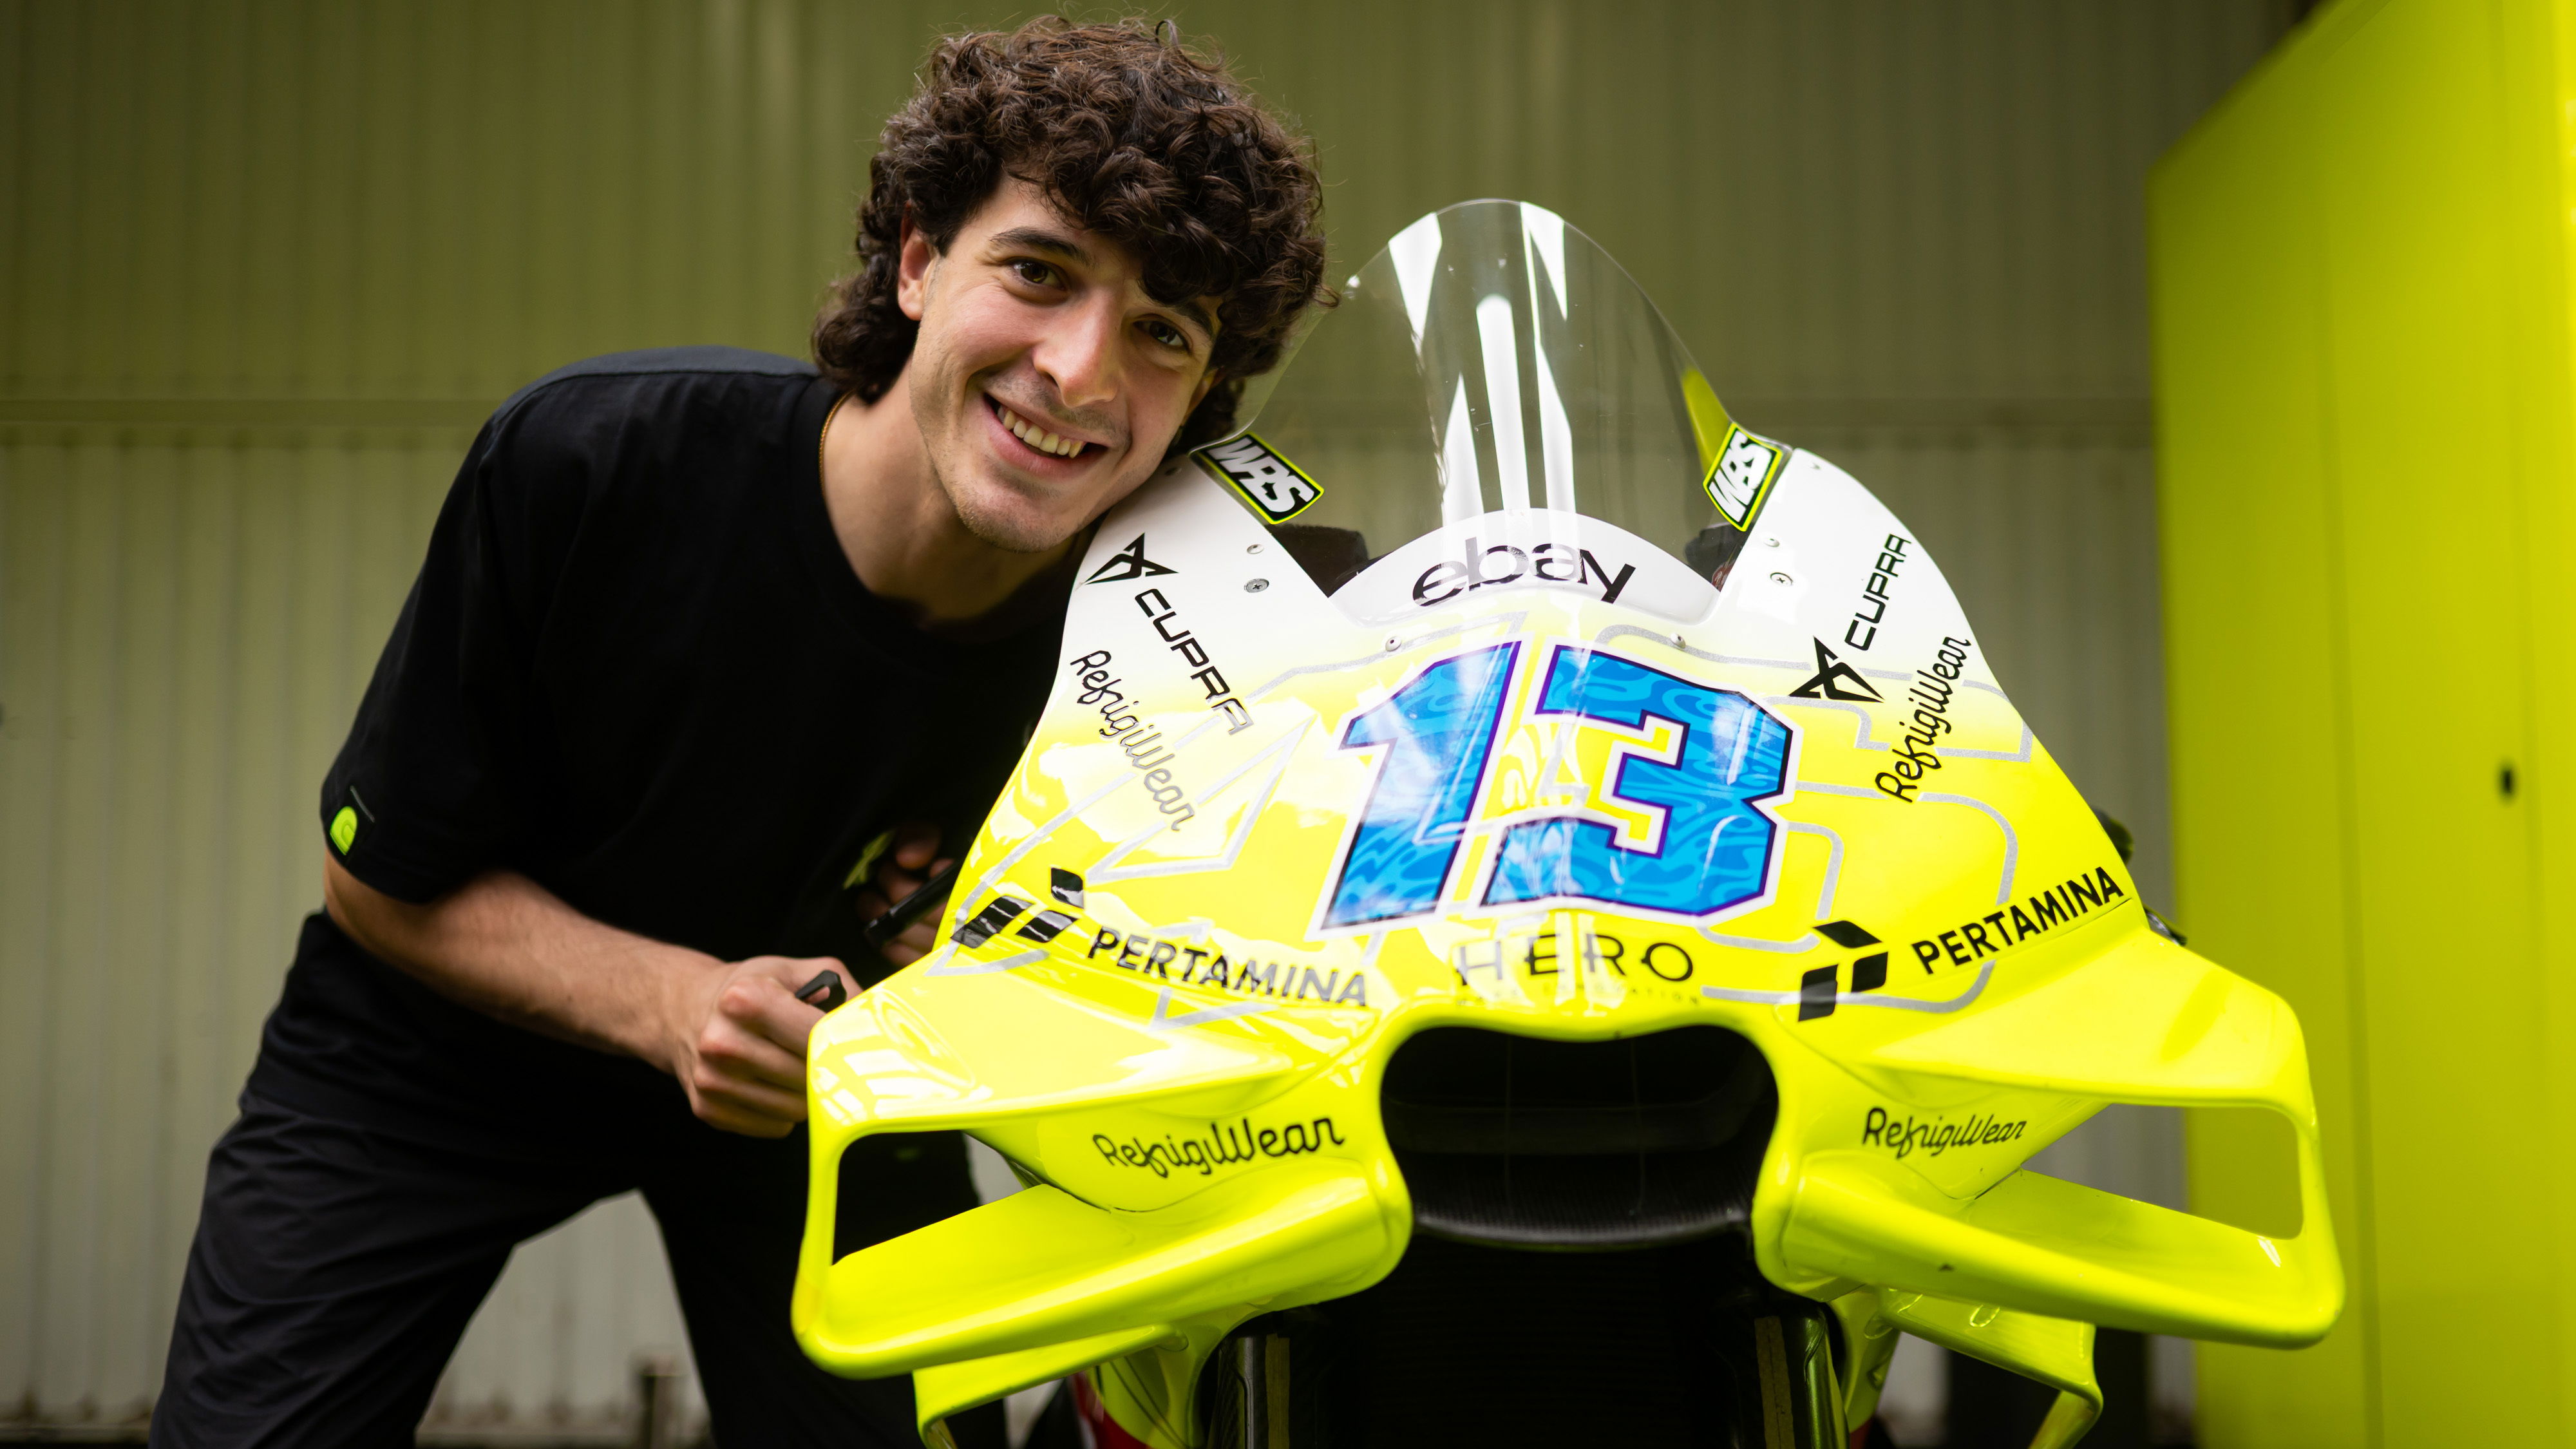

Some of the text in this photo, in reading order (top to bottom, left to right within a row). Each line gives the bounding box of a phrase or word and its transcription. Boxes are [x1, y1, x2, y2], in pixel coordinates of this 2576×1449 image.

[1206, 437, 1315, 513] WRS
[1708, 430, 1772, 523] WRS
[1412, 536, 1636, 607] ebay
[1844, 534, 1913, 651] CUPRA
[1134, 588, 1254, 735] CUPRA
[1070, 649, 1195, 831] RefrigiWear
[1875, 636, 1971, 803] RefrigiWear
[1314, 638, 1797, 935] 13
[1087, 925, 1367, 1007] PERTAMINA
[1455, 933, 1694, 986] HERO
[1911, 866, 2125, 975] PERTAMINA
[1092, 1117, 1345, 1179] RefrigiWear
[1862, 1107, 2027, 1160] RefrigiWear
